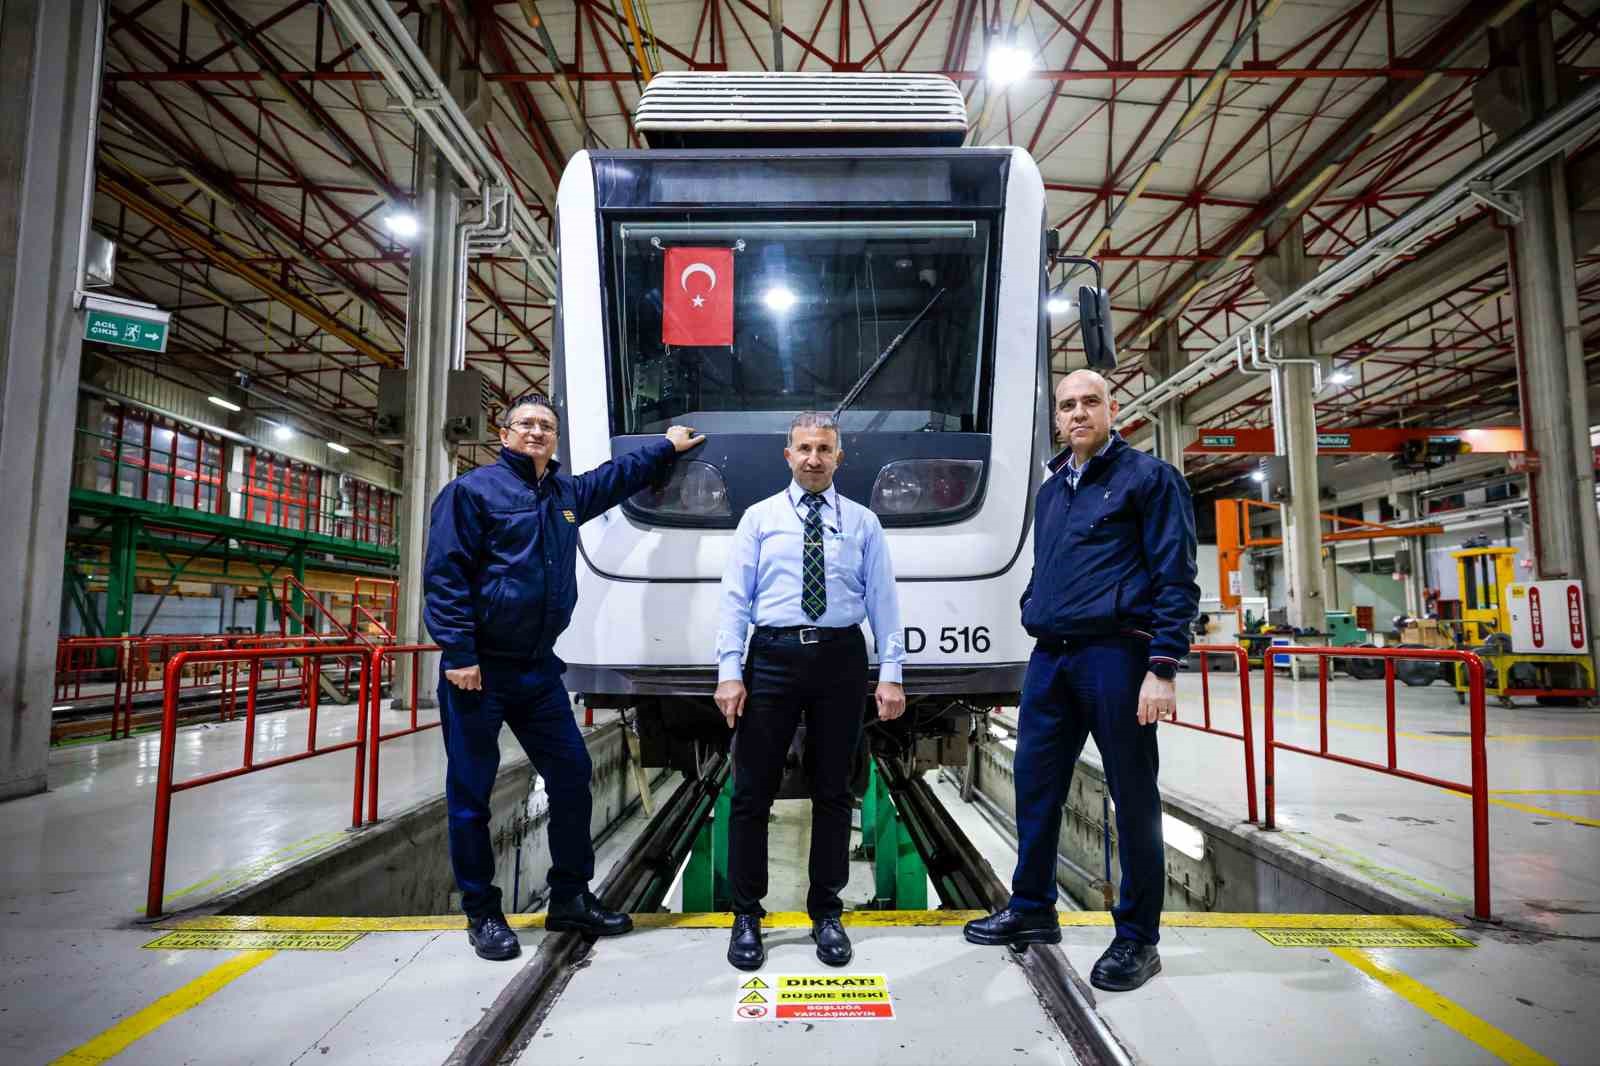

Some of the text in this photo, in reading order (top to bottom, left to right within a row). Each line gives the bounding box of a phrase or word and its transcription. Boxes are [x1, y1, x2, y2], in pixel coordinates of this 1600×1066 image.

[904, 626, 990, 653] D 516
[787, 978, 875, 986] DİKKAT!
